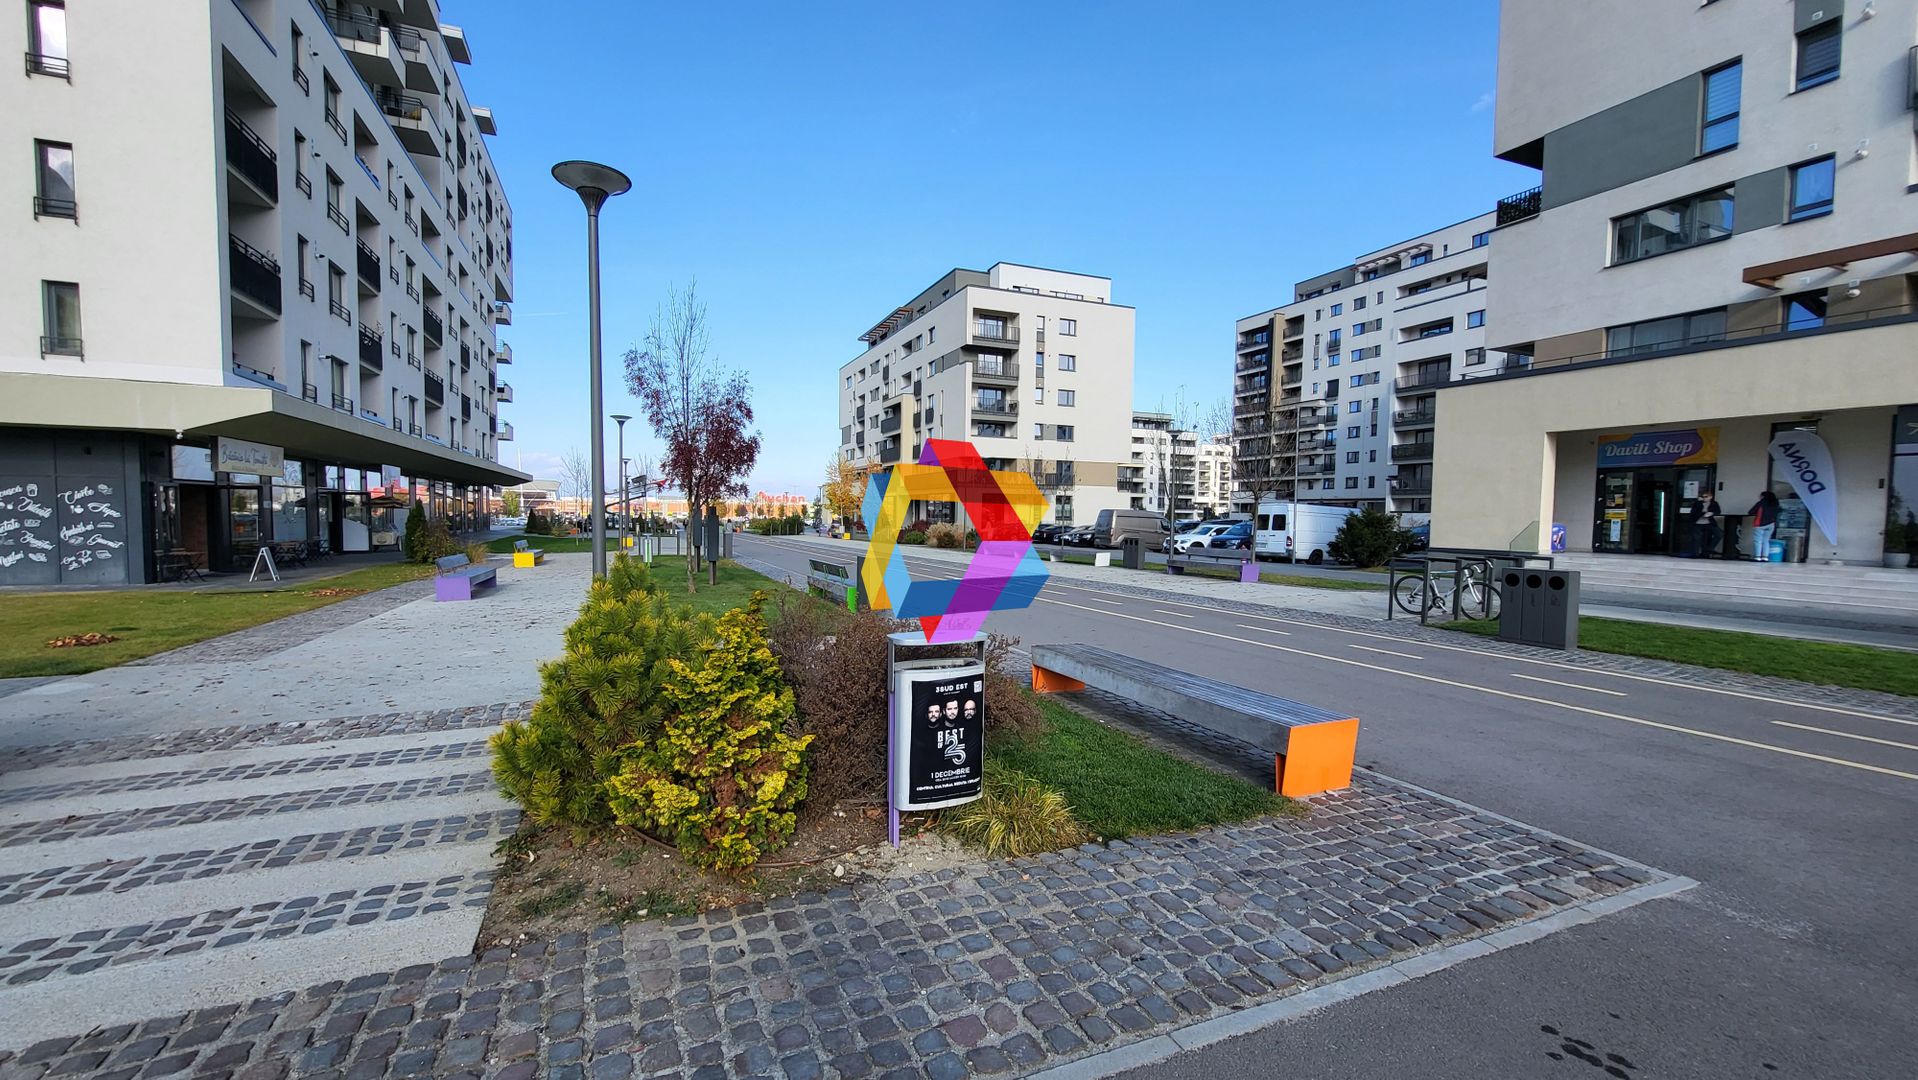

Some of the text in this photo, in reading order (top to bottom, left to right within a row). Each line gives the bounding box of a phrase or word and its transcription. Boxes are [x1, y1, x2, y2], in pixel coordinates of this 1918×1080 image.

[1653, 441, 1693, 456] Shop
[57, 486, 95, 504] Ciorbe
[87, 502, 122, 518] Supe
[955, 682, 968, 691] EST
[937, 727, 965, 743] BEST
[944, 735, 966, 765] 25
[934, 766, 971, 779] DECEMBRIE
